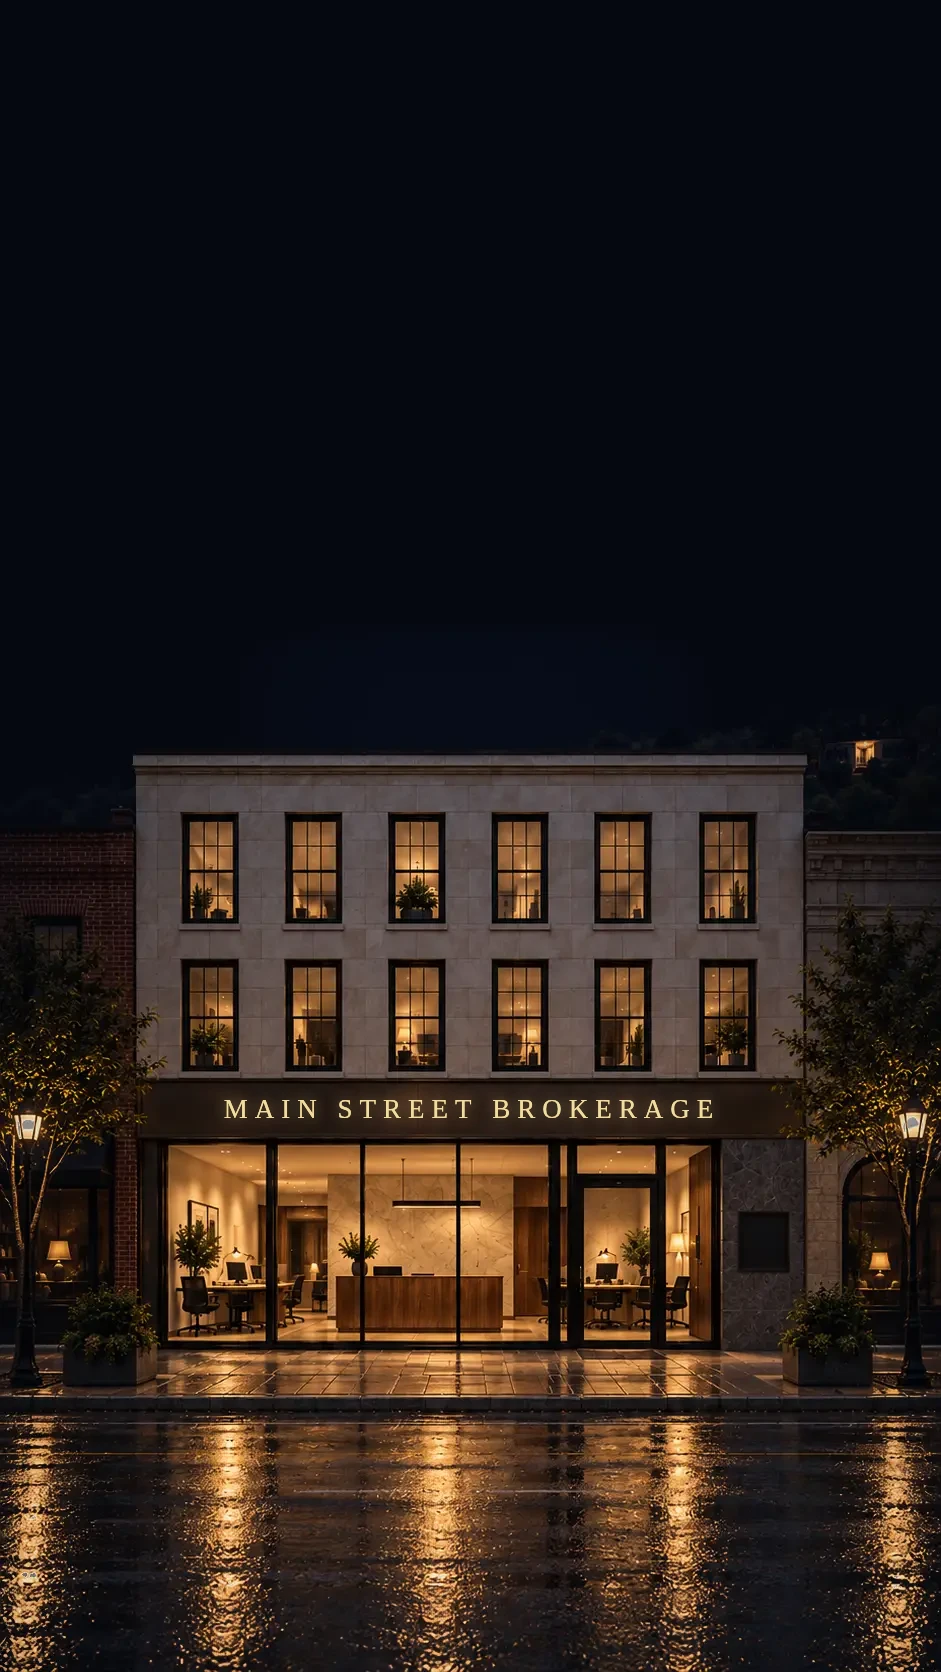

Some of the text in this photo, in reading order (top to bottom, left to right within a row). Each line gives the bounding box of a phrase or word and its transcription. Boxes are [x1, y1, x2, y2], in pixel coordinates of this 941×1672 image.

[223, 1099, 714, 1120] MAIN STREET BROKERAGE
